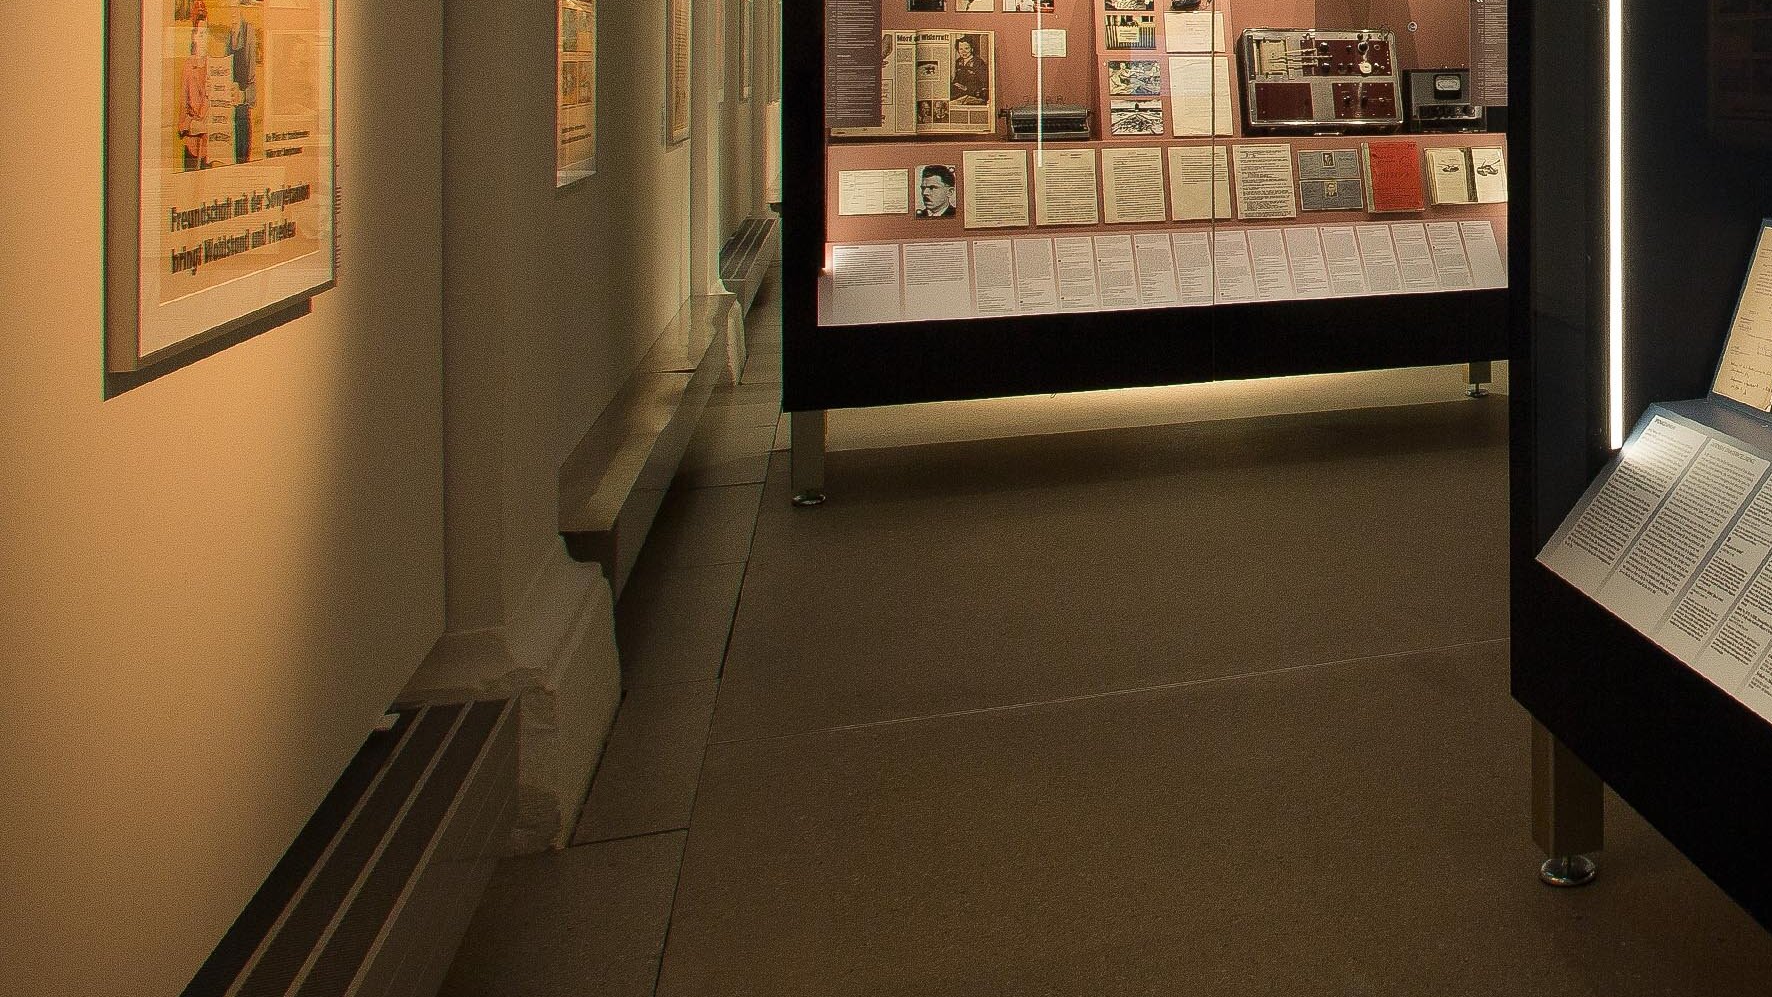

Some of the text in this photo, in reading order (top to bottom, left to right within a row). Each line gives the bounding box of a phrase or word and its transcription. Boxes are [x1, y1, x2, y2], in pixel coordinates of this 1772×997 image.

[171, 196, 232, 233] Freundschaft
[233, 192, 248, 217] mit
[250, 189, 263, 214] der
[171, 244, 202, 276] bringt
[251, 222, 266, 249] und
